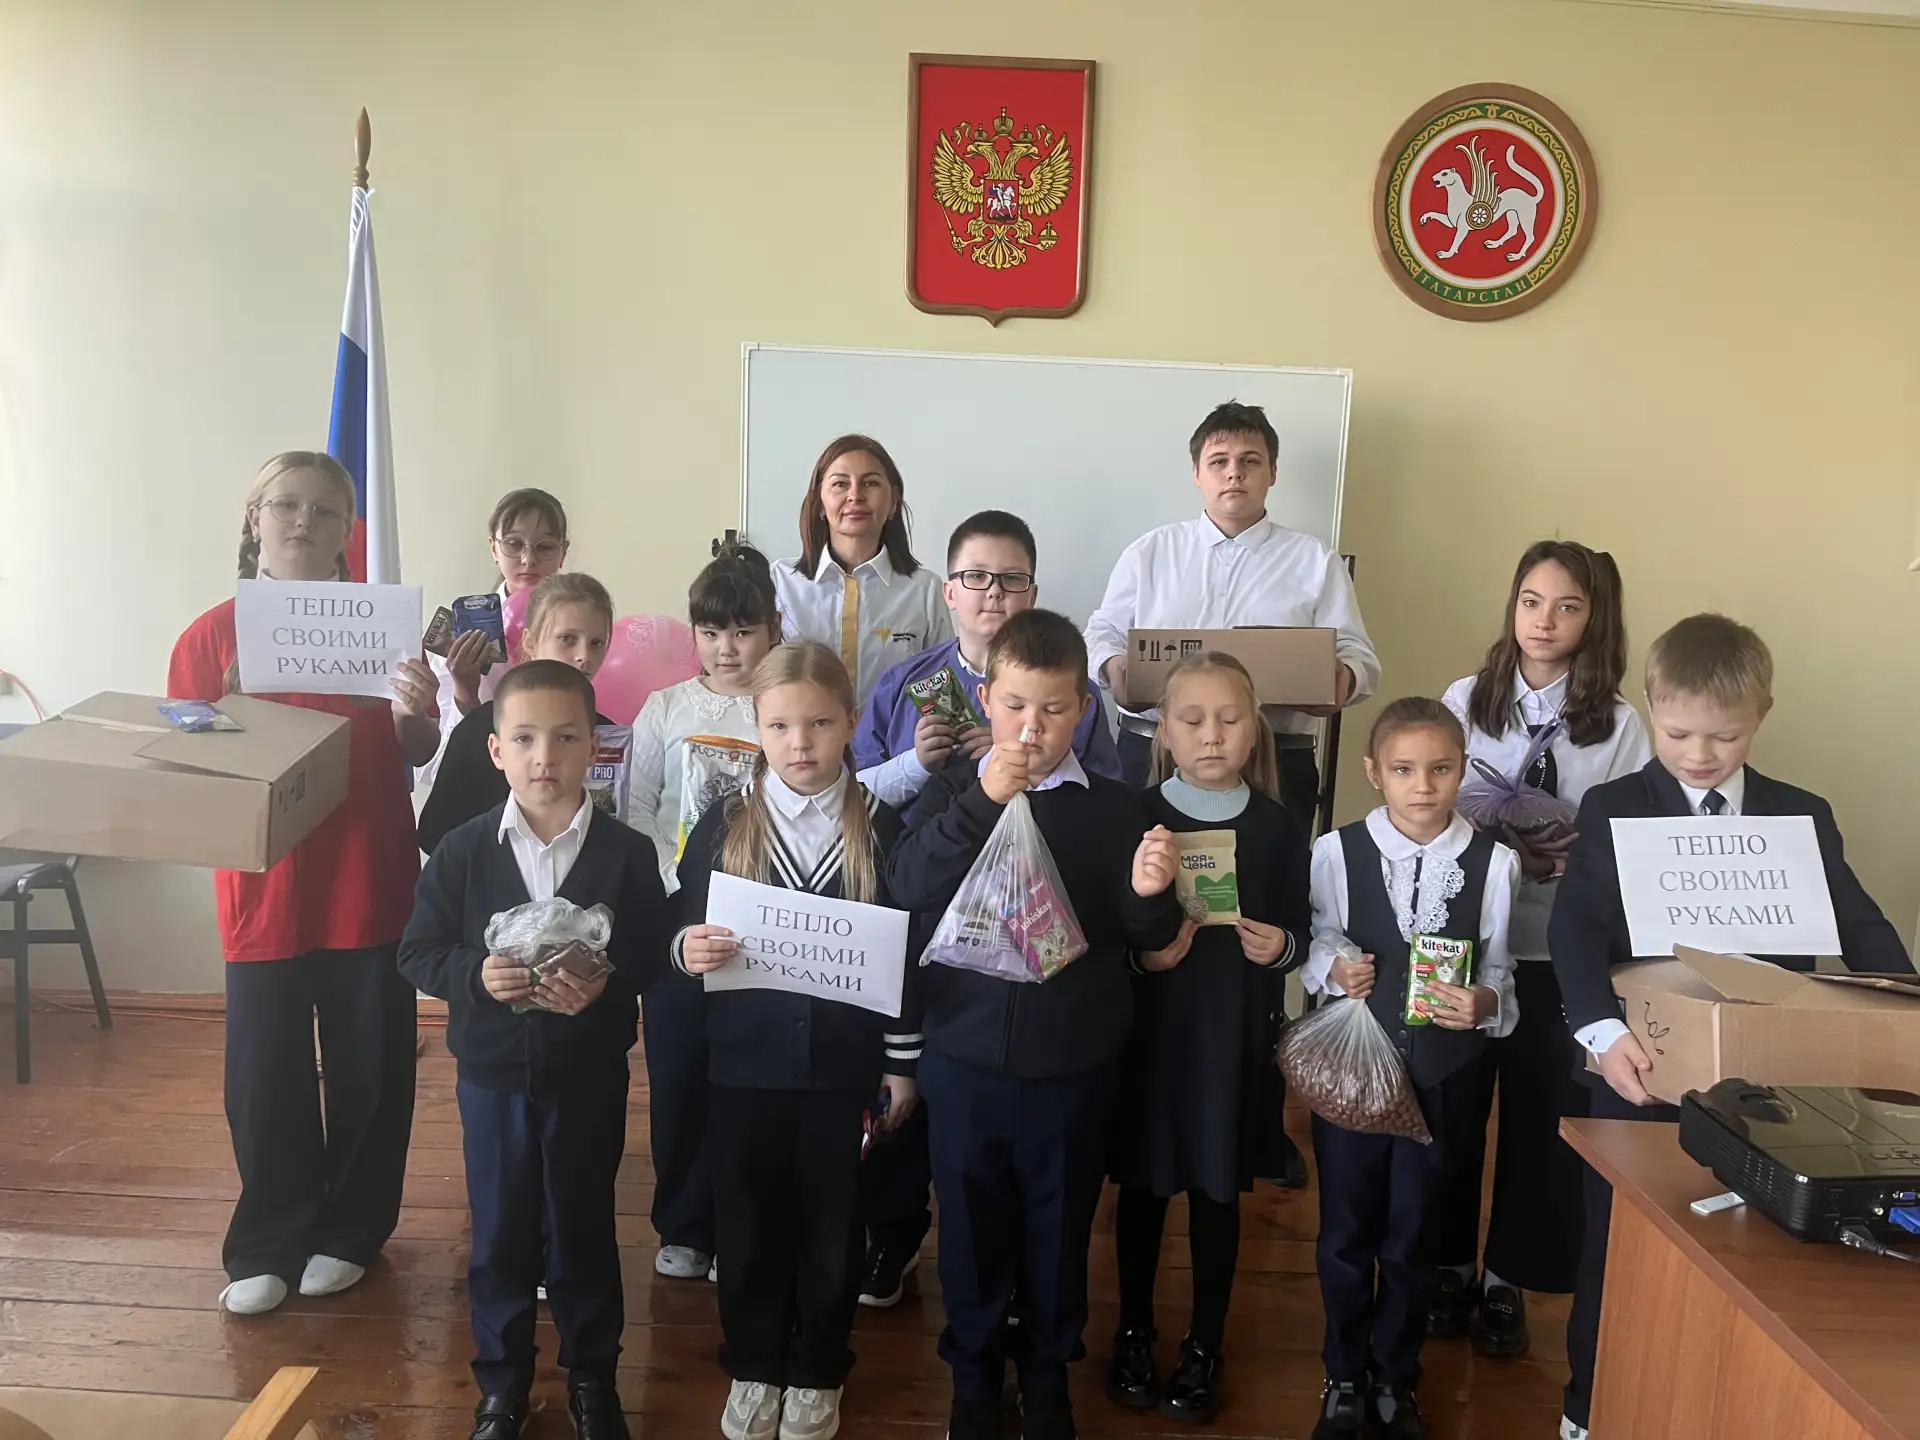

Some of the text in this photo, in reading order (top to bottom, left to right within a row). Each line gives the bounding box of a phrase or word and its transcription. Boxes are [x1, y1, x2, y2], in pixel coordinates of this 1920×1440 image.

[1420, 273, 1528, 302] ТАТАРСТАН
[286, 597, 374, 618] ТЕПЛО
[272, 627, 389, 649] СВОИМИ
[275, 656, 388, 675] РУКАМИ
[913, 673, 946, 694] kitekat
[594, 766, 613, 779] PRO
[1668, 834, 1767, 856] ТЕПЛО
[1658, 869, 1790, 892] СВОИМИ
[757, 904, 853, 936] ТЕПЛО
[1020, 900, 1053, 931] whiskas
[1666, 904, 1796, 925] РУКАМИ
[741, 935, 867, 966] СВОИМИ
[1421, 938, 1460, 953] kitekat
[745, 957, 864, 992] РУКАМИ
